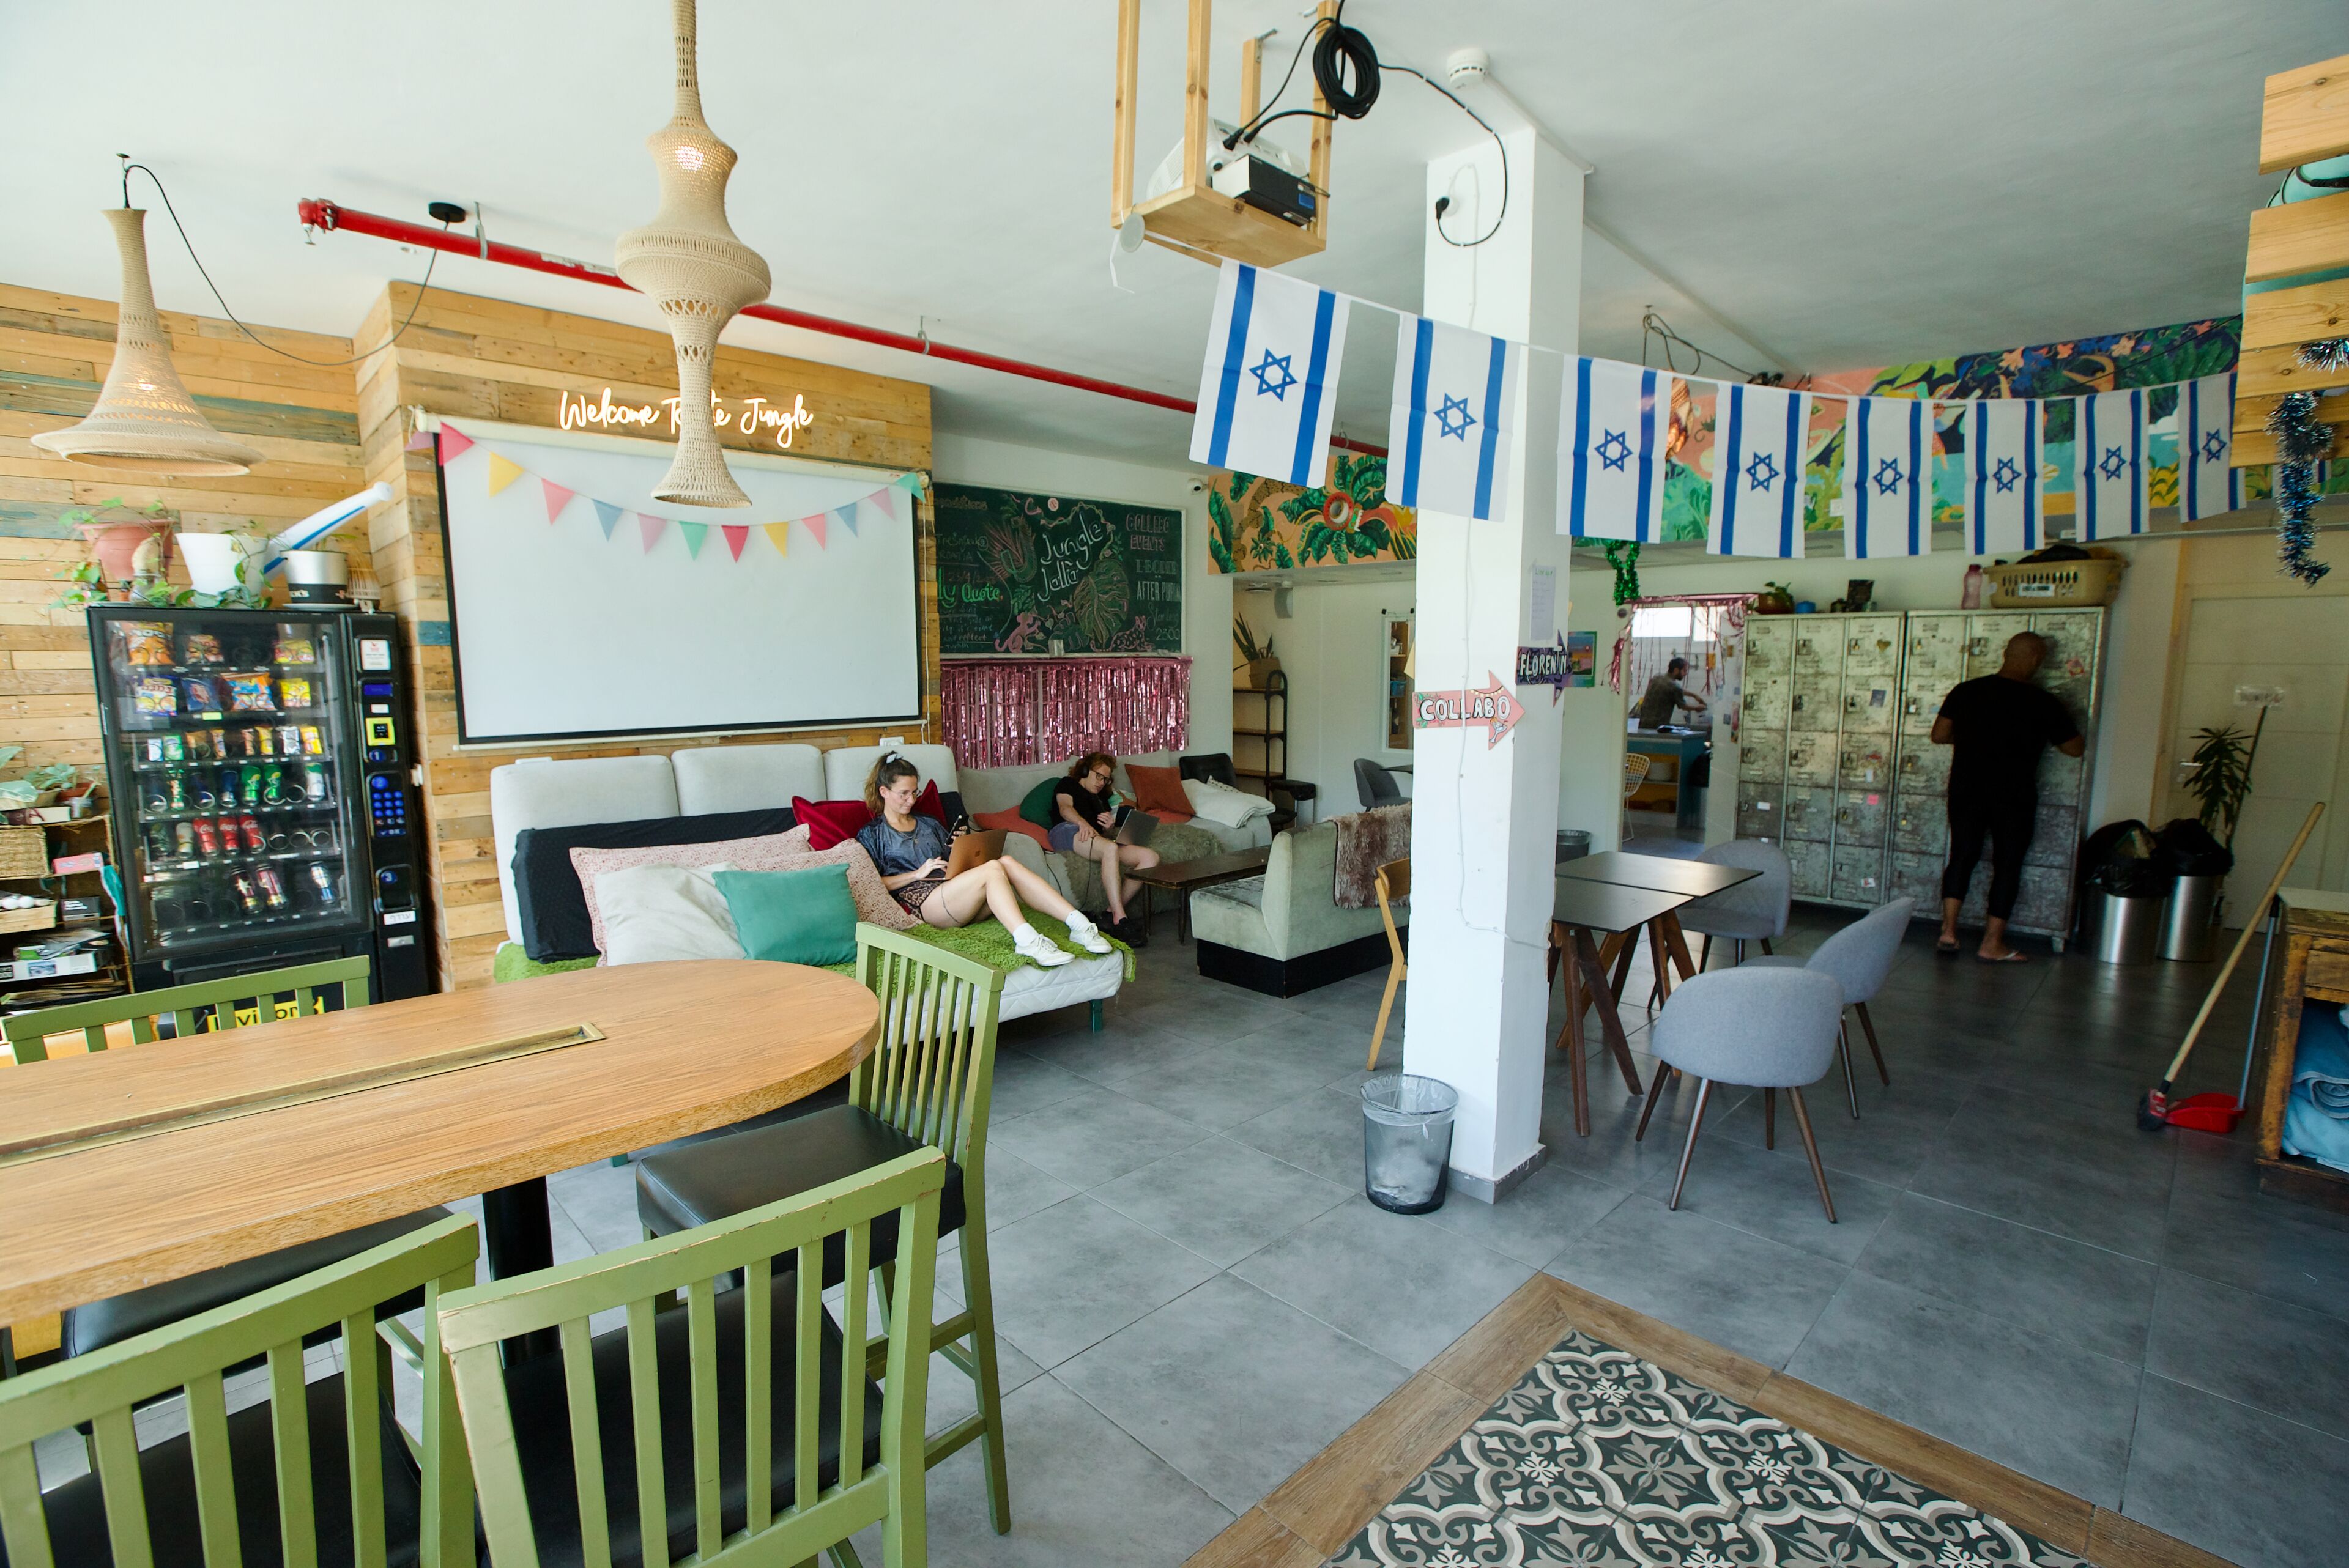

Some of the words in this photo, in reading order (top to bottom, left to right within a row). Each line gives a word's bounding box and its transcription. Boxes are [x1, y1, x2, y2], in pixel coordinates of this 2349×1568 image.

[559, 387, 660, 430] Welcome
[740, 393, 814, 448] Jungle
[1040, 511, 1104, 571] Jungle
[1130, 534, 1165, 552] EVENTS
[1137, 580, 1160, 601] AFTER
[1520, 645, 1567, 676] FLORENTIN
[1419, 695, 1511, 722] COLLABO
